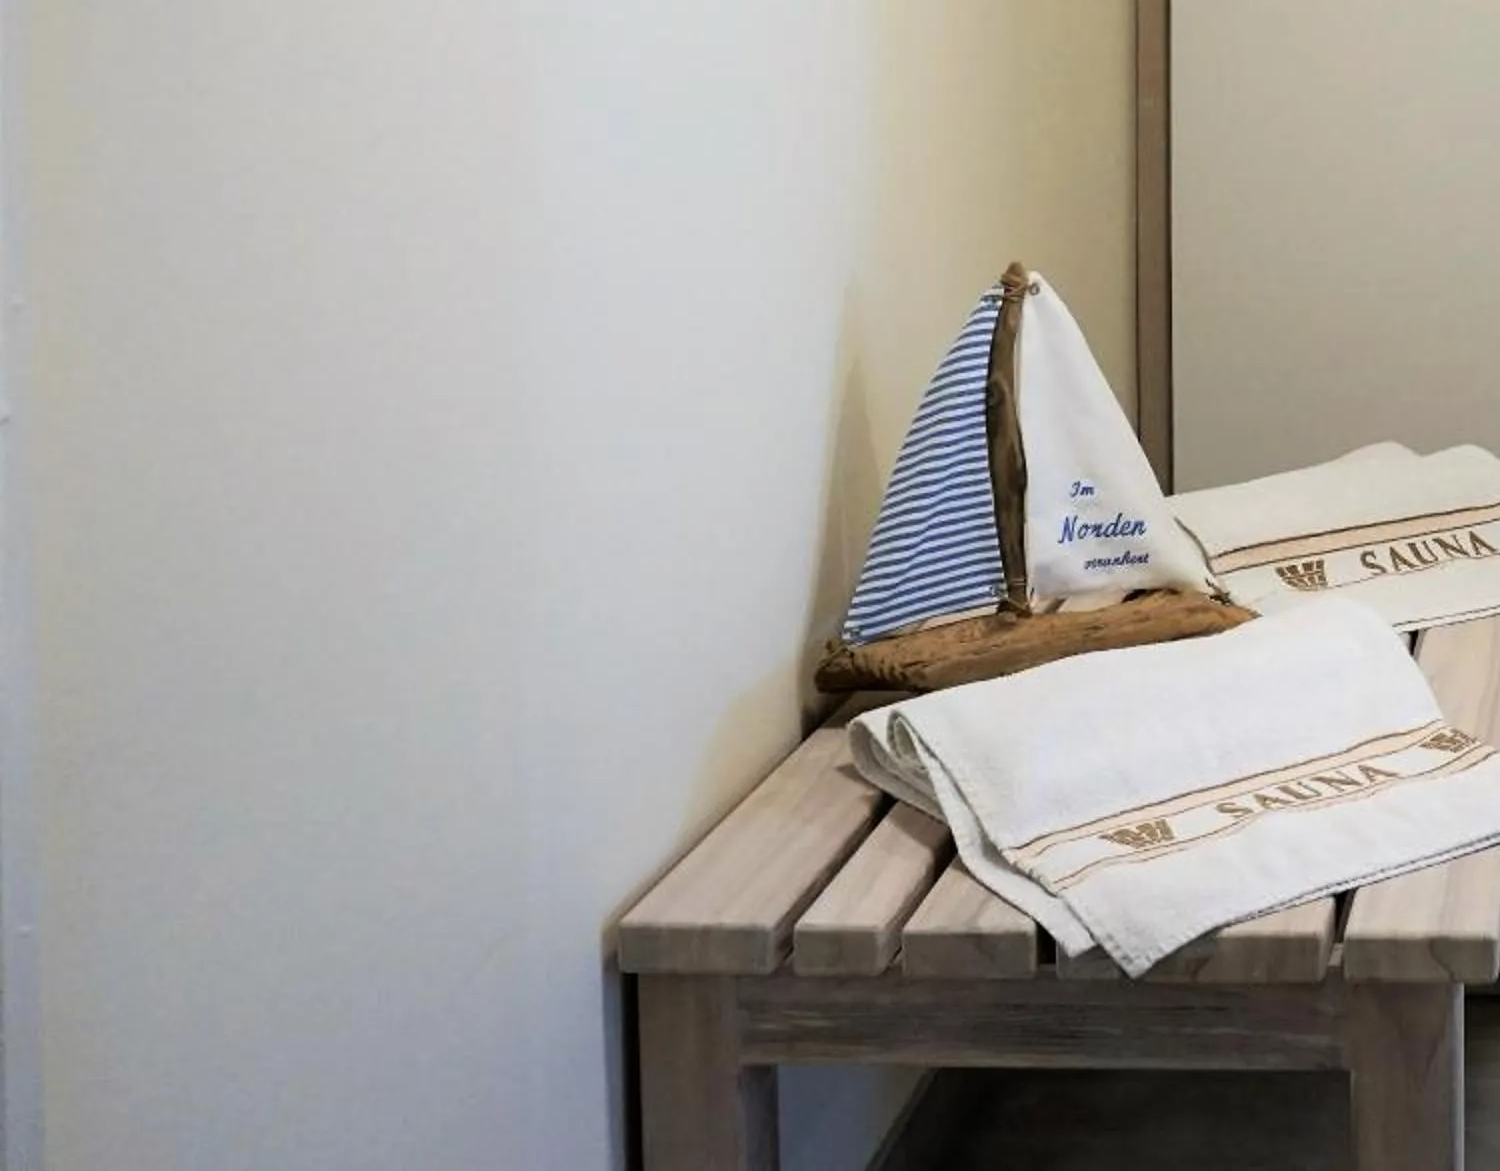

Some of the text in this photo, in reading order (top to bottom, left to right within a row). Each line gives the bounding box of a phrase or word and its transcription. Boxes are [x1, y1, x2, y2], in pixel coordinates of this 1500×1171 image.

[1069, 480, 1095, 498] Im
[1057, 512, 1147, 544] Norden
[1359, 530, 1499, 577] SAUNA
[1214, 763, 1399, 820] SAUNA
